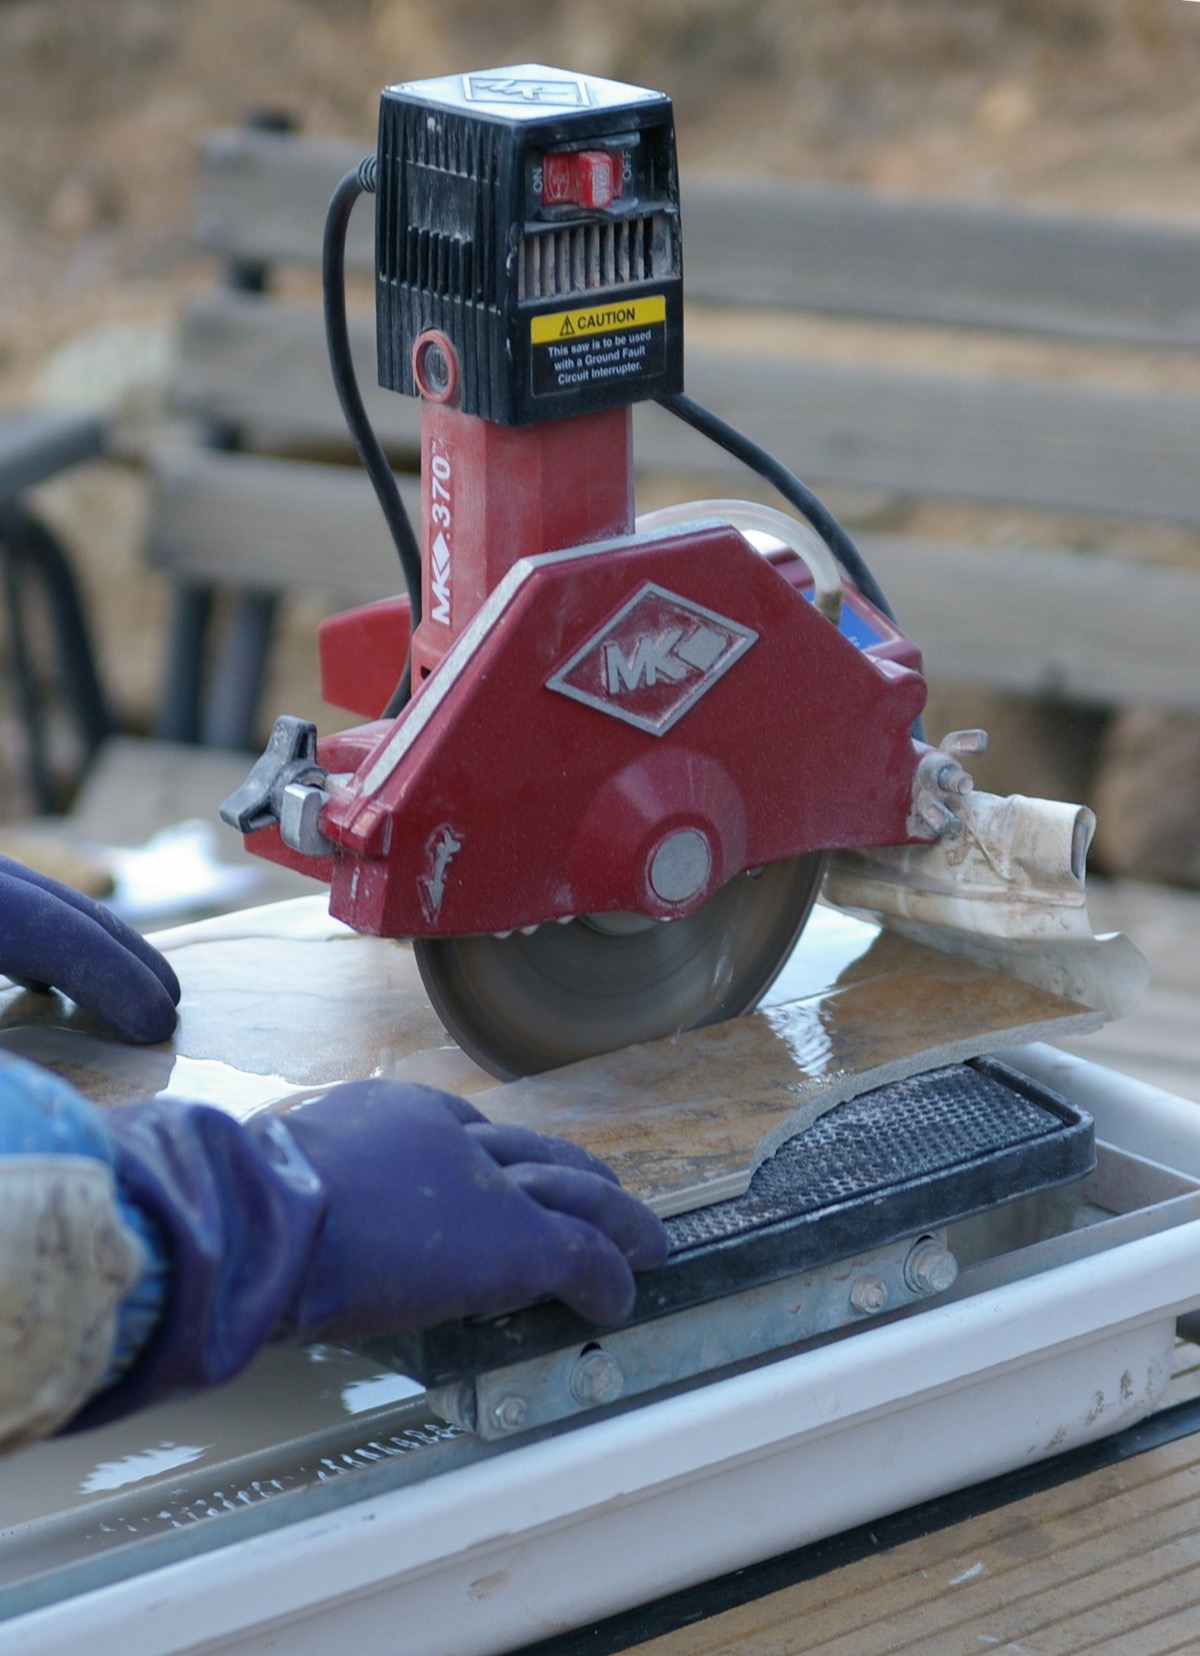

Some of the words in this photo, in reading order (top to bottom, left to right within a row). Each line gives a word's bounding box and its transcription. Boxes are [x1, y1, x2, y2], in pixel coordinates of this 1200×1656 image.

[622, 149, 632, 181] OFF
[533, 167, 543, 193] ON
[577, 307, 636, 330] CAUTION
[548, 345, 568, 358] This
[571, 341, 590, 353] saw
[592, 338, 600, 349] is
[603, 336, 613, 348] to
[615, 334, 626, 346] be
[629, 329, 652, 341] used
[554, 358, 574, 371] with
[577, 358, 583, 367] a
[585, 350, 620, 365] Ground
[622, 345, 646, 358] Fault
[558, 370, 589, 385] Circuit
[591, 361, 642, 377] Interrupter.
[432, 455, 450, 528] 370
